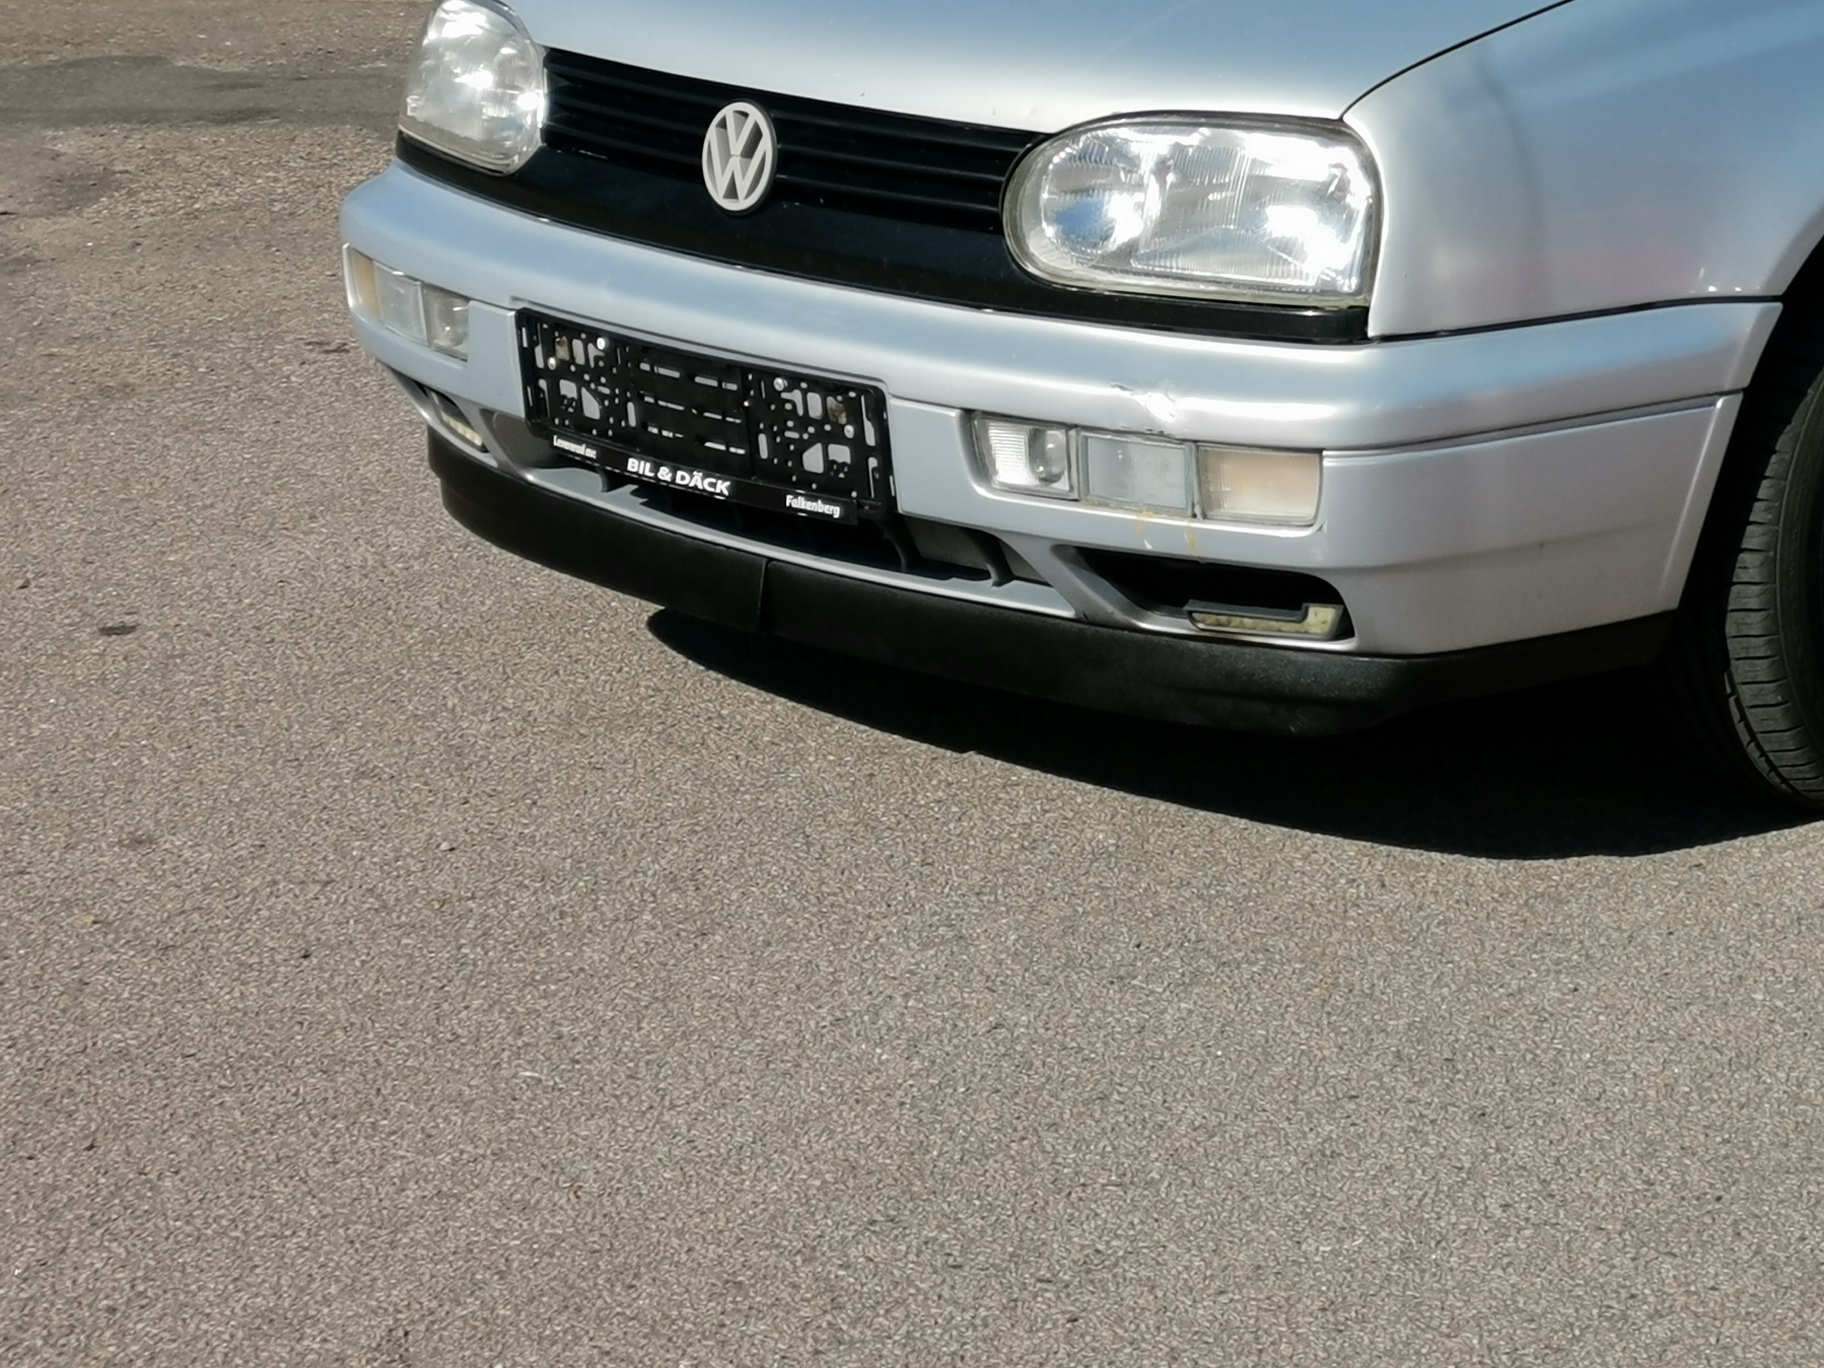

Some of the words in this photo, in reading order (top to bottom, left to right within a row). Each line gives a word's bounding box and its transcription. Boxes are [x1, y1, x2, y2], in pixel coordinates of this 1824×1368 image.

[627, 457, 655, 477] BIL
[657, 465, 672, 483] &
[675, 470, 732, 496] DÄCK
[785, 494, 841, 519] Falkenberg
